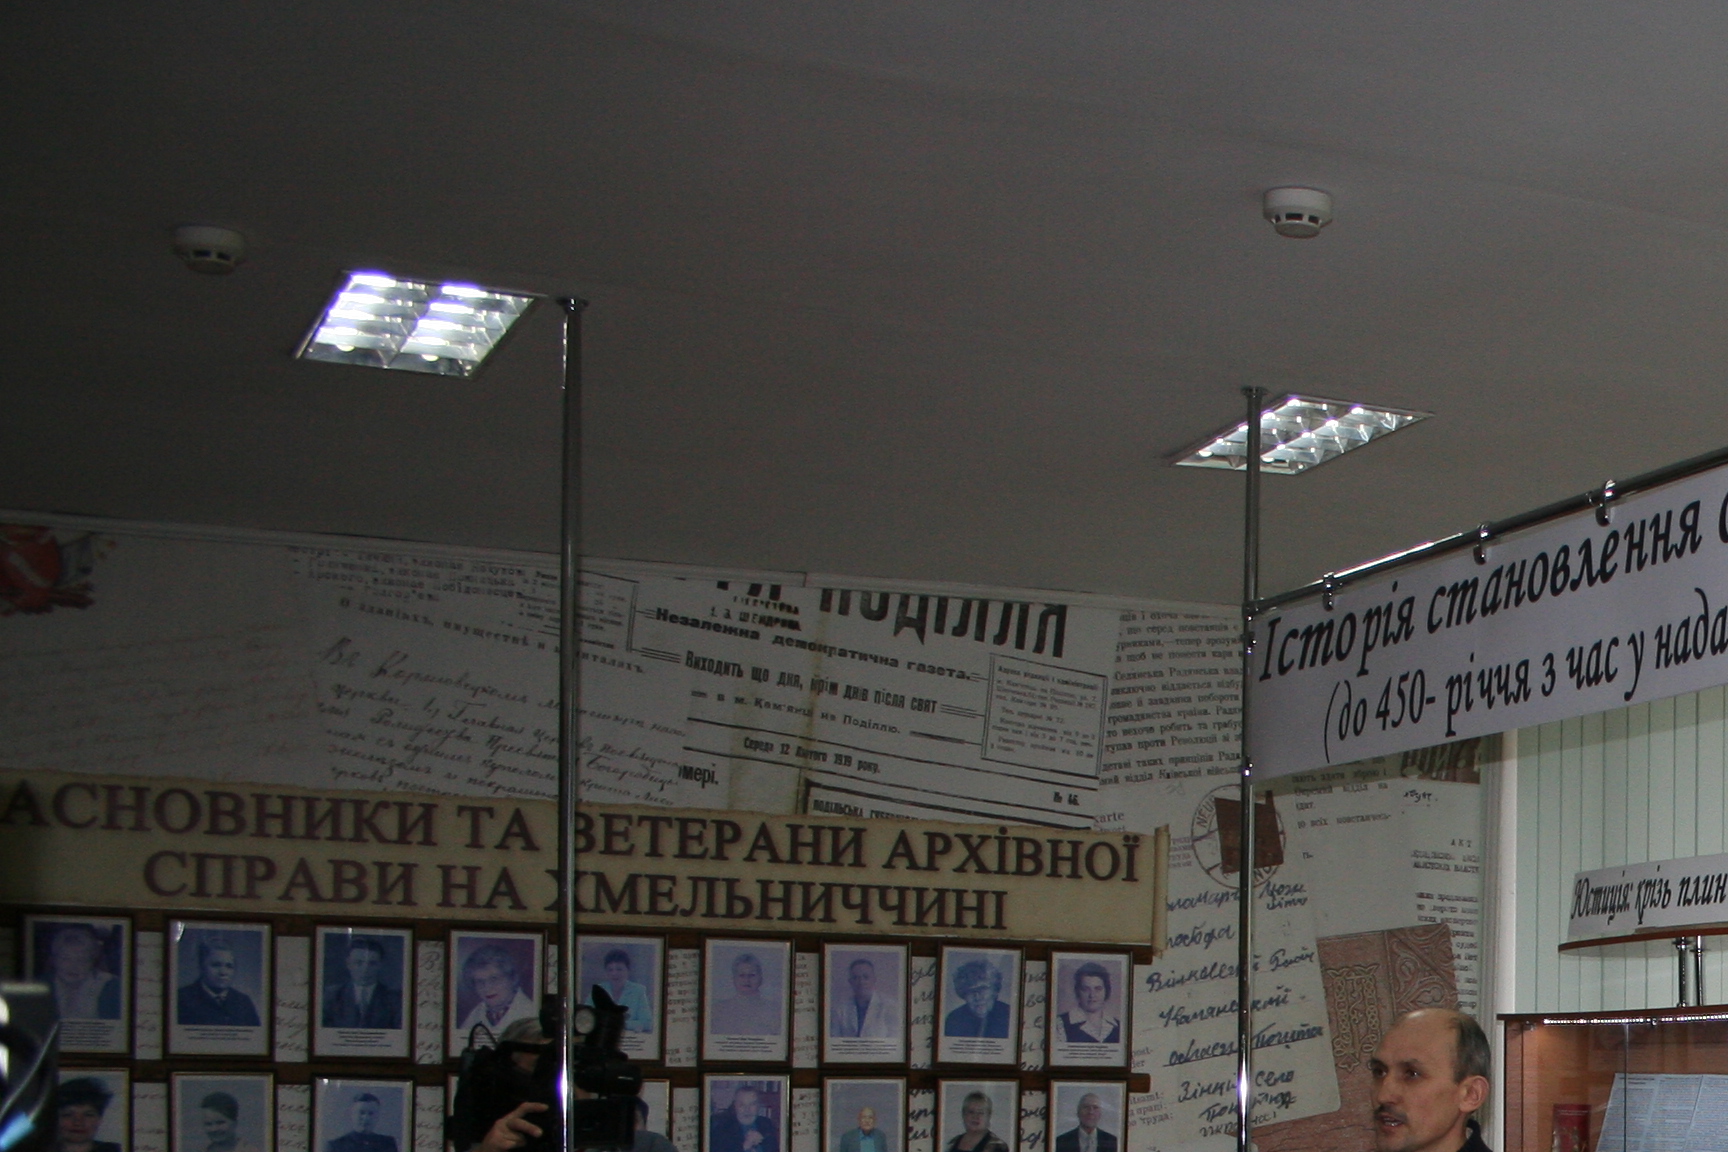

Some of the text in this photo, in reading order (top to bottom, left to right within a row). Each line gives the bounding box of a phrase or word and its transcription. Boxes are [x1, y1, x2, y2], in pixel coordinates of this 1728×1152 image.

[1259, 585, 1415, 684] Історія
[1427, 498, 1702, 634] становлення
[655, 608, 760, 640] Незалежна
[771, 634, 899, 668] демократична
[906, 660, 971, 682] газета.
[1127, 652, 1146, 662] щоб
[686, 651, 743, 678] Виходить
[751, 666, 769, 682] що
[777, 672, 803, 690] дня,
[810, 677, 838, 697] крім
[843, 685, 868, 702] днів
[875, 688, 905, 709] після
[1323, 681, 1368, 764] (до
[1541, 658, 1558, 698] з
[1566, 630, 1644, 702] часу
[717, 694, 725, 702] в
[735, 697, 747, 706] м.
[821, 712, 836, 722] на
[843, 714, 901, 734] Поділлю.
[678, 763, 719, 787] мері.
[780, 743, 790, 755] 12
[857, 760, 880, 774] року.
[0, 779, 1140, 883] АСНОВНИКИ ТА ВЕТЕРАНИ АРХІВНОЇ
[143, 851, 1007, 931] СПРАВИ НА ХМЕЛЬНИЧЧИНІ
[1635, 865, 1672, 925] крізь
[1677, 873, 1728, 907] плин
